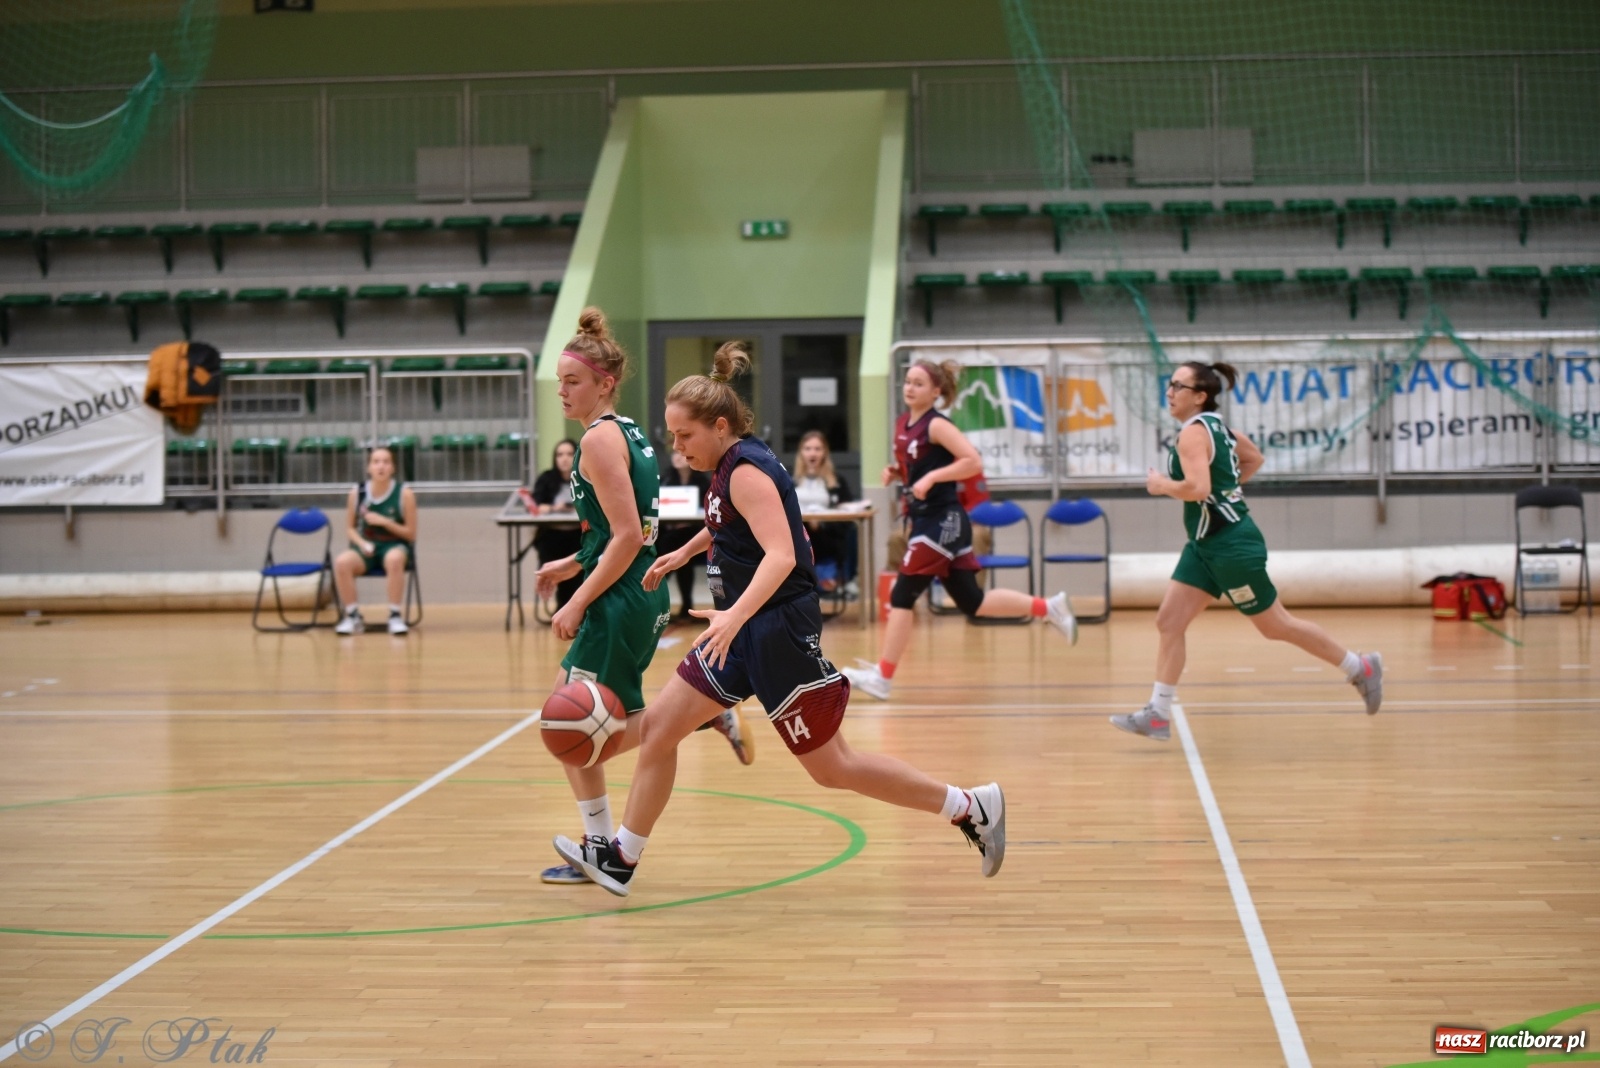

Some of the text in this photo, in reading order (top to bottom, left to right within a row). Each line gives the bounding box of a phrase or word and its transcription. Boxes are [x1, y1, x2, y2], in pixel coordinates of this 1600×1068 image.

[0, 385, 138, 445] ORZĄDKU!
[707, 491, 722, 523] 14
[784, 715, 811, 744] 14
